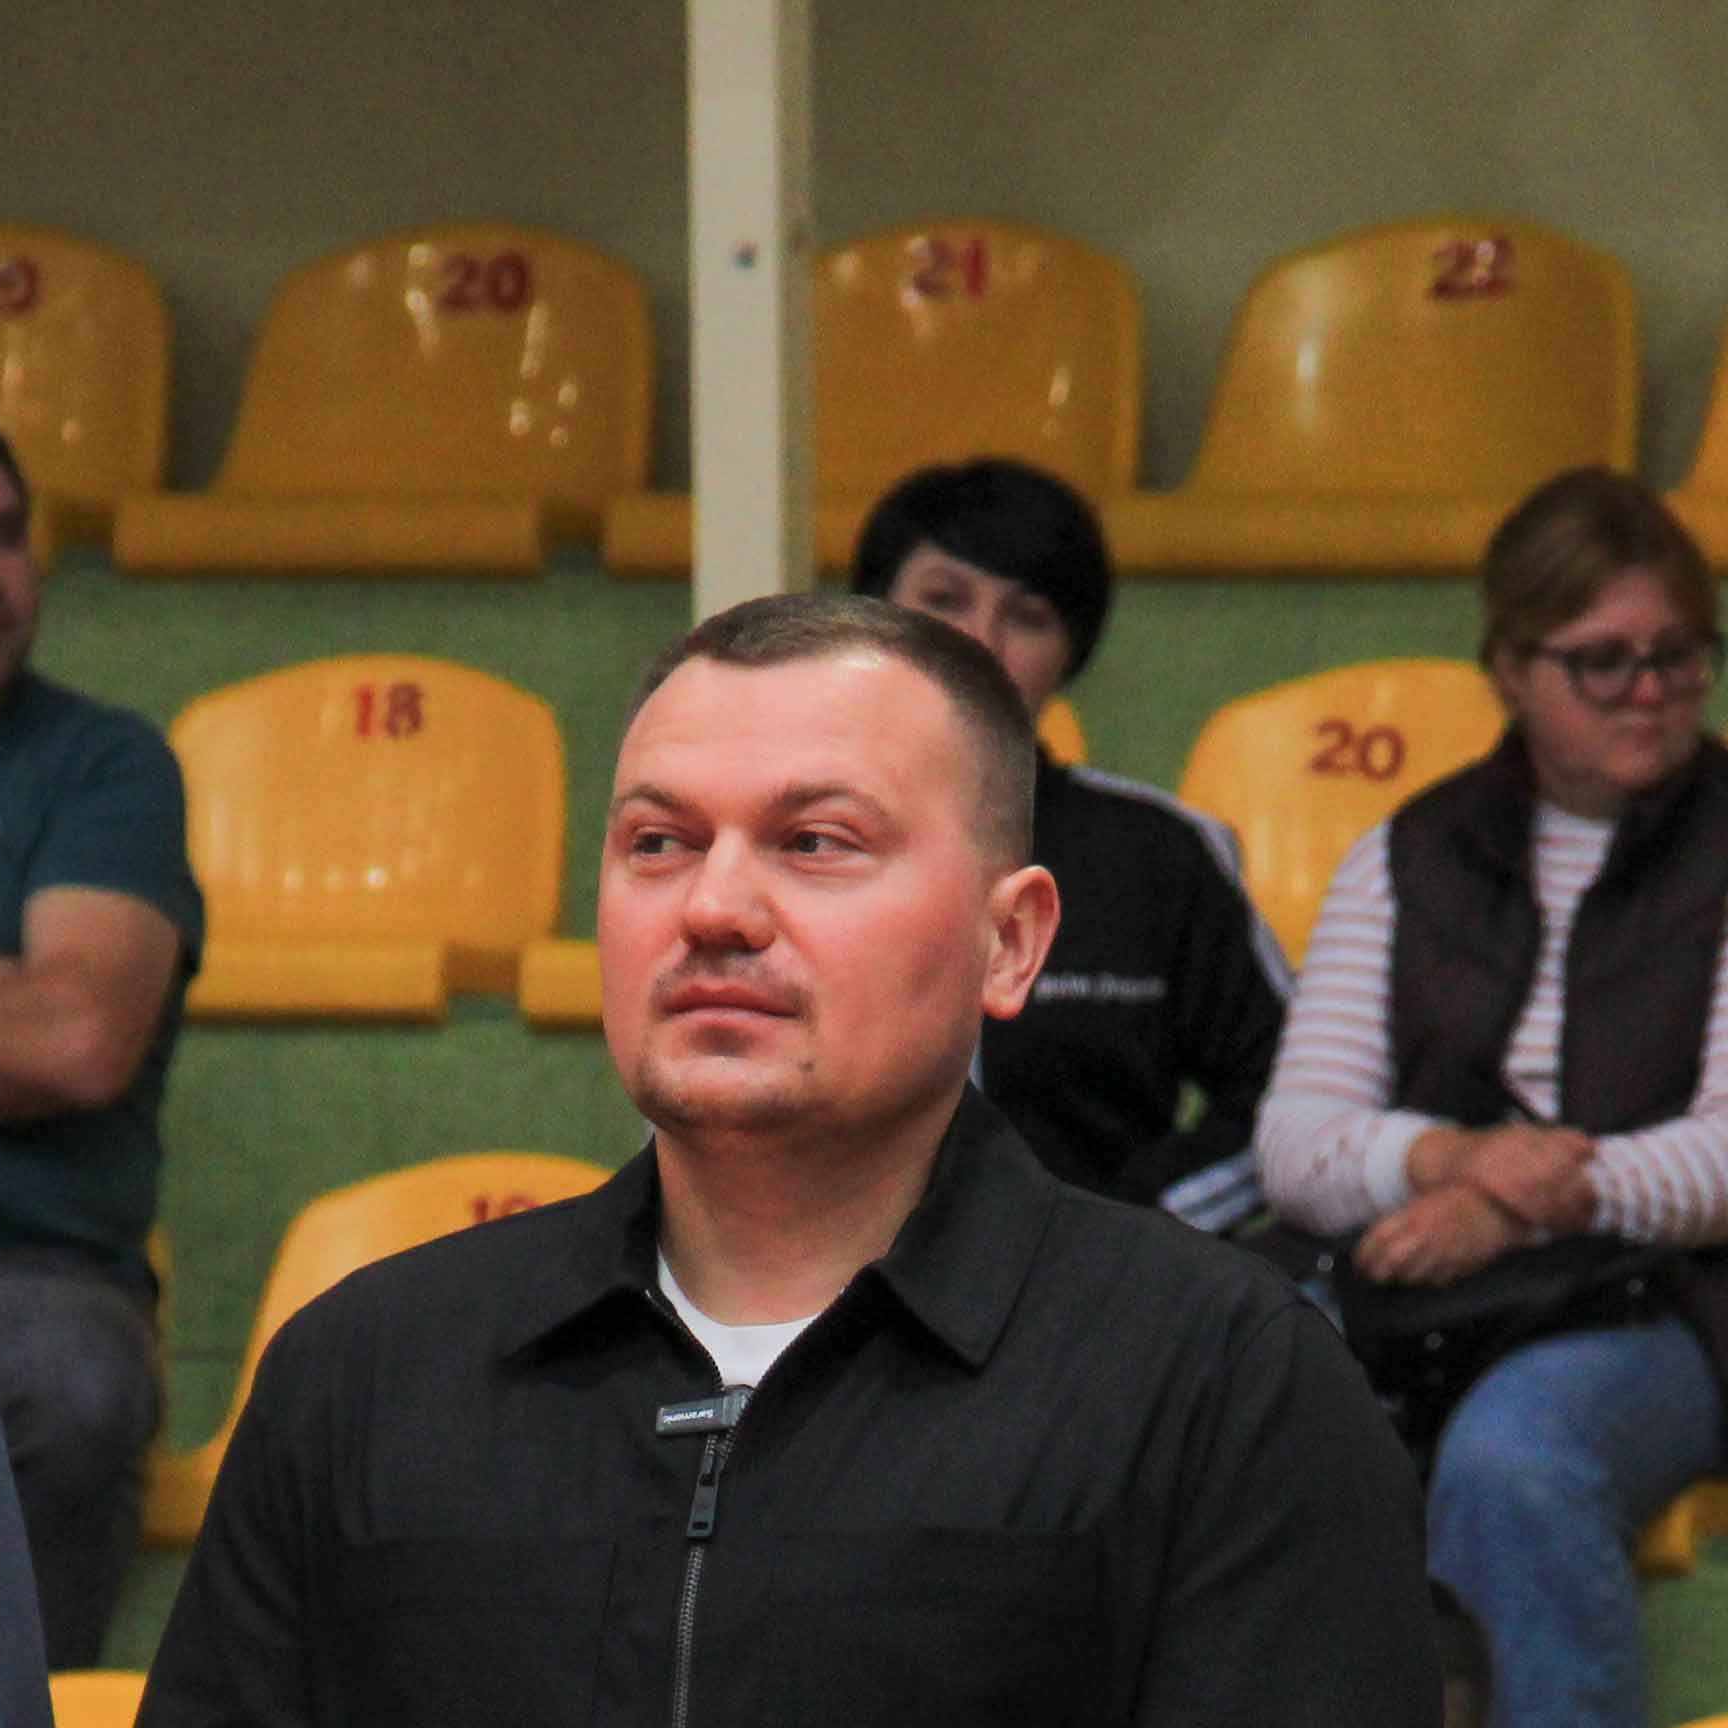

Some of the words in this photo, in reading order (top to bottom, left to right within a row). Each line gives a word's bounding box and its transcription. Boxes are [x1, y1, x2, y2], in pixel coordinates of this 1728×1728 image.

[442, 250, 533, 314] 20
[911, 238, 988, 298] 21
[1429, 235, 1515, 301] 22
[355, 681, 425, 741] 18
[1307, 718, 1407, 783] 20
